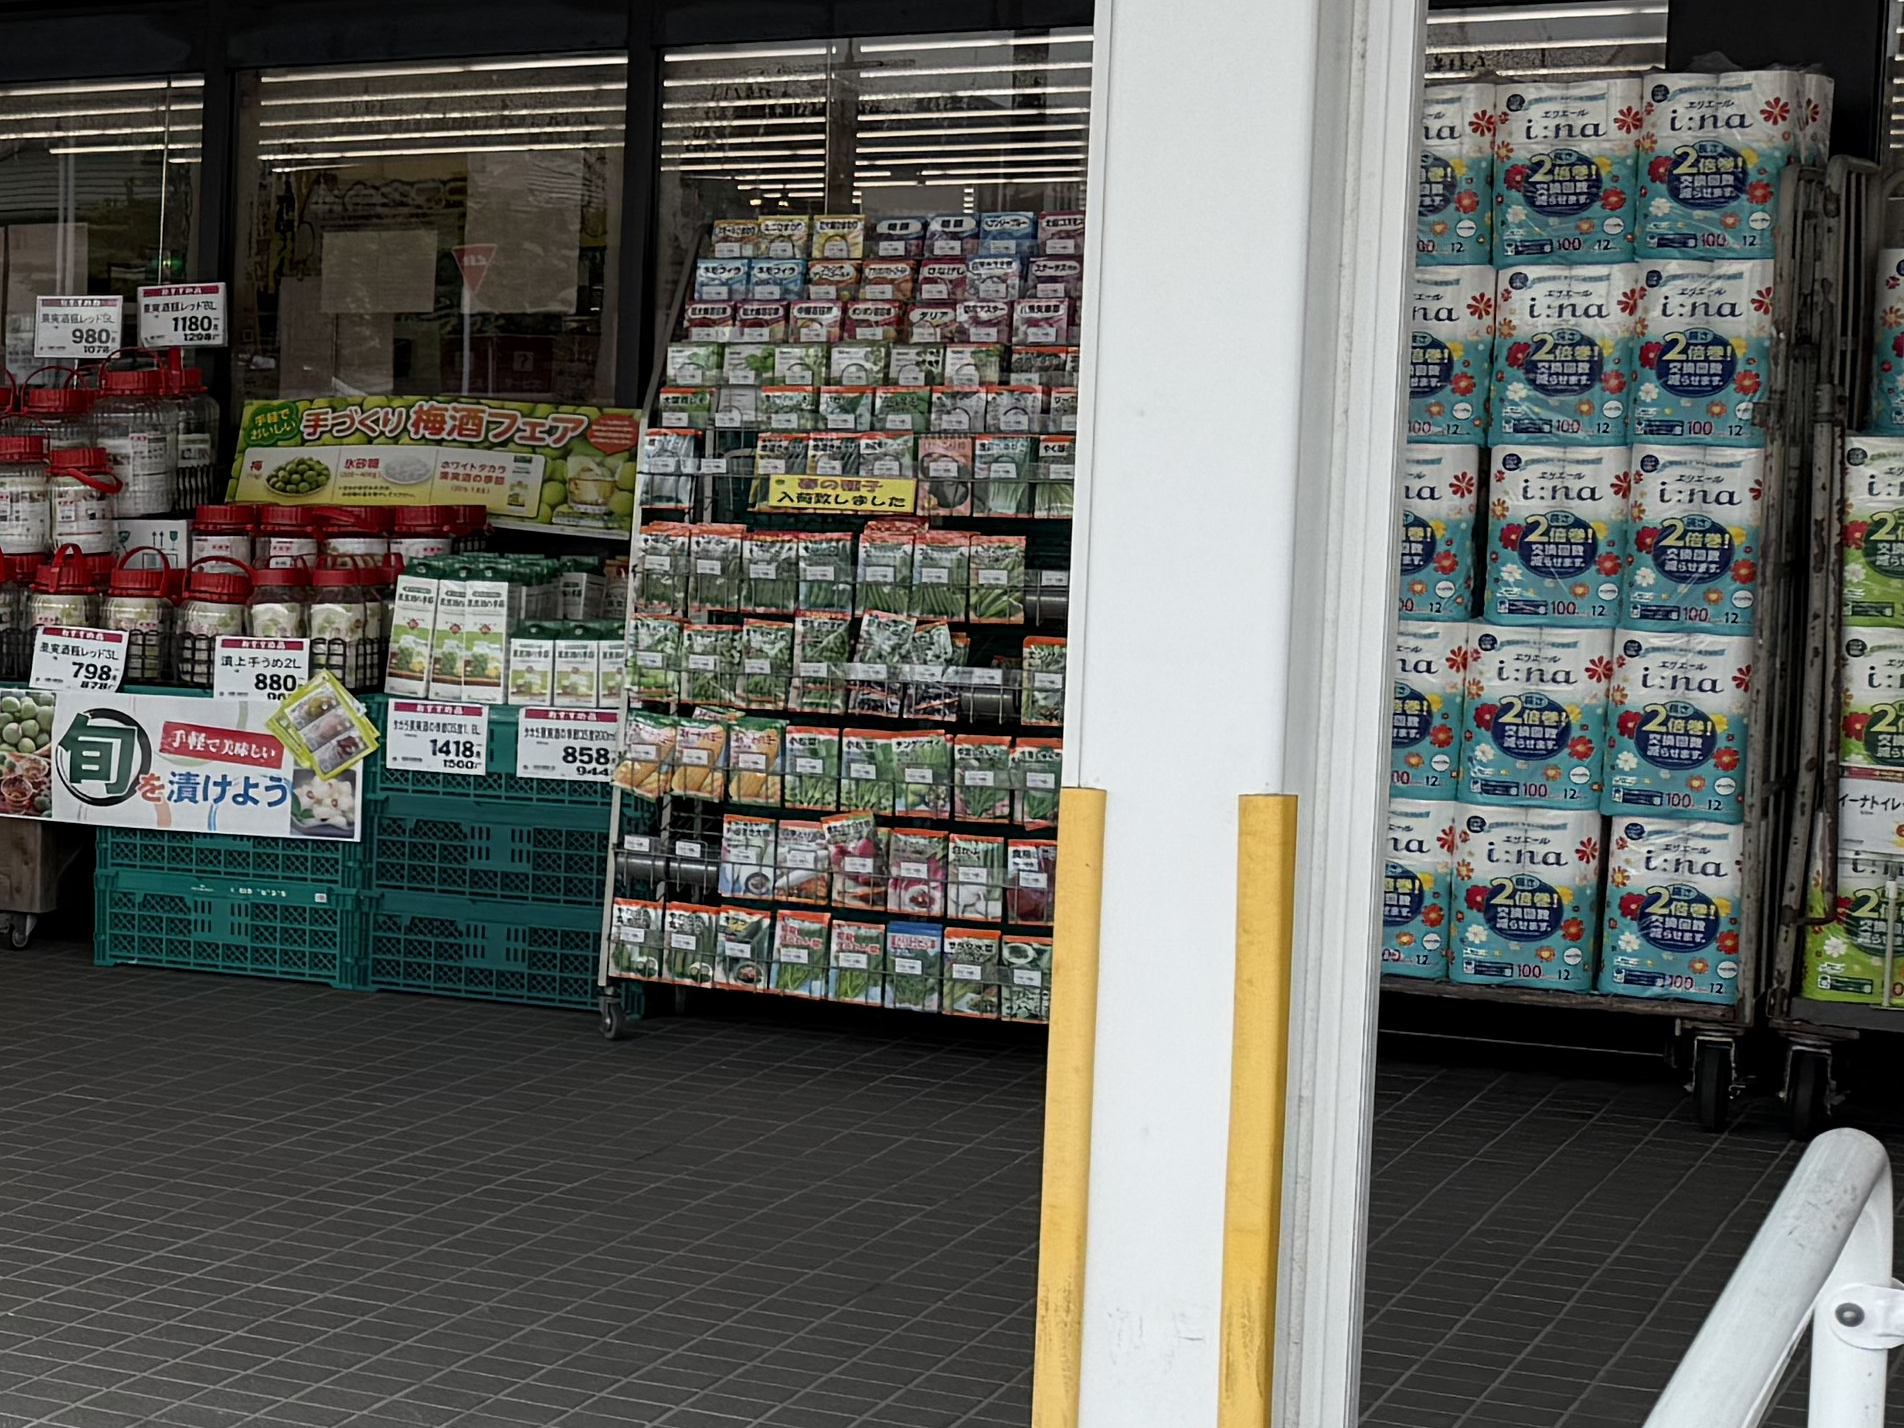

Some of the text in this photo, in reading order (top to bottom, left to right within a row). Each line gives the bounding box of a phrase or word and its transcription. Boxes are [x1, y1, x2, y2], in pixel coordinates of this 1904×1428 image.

[1557, 237, 1582, 250] 100
[1596, 239, 1612, 250] 12
[1701, 232, 1728, 247] 100
[1742, 234, 1757, 247] 12
[1450, 243, 1465, 253] 12
[172, 316, 213, 332] 1180
[71, 328, 111, 344] 980
[300, 401, 589, 449] 手づくり梅酒フェア
[1445, 422, 1462, 435] 12
[1555, 419, 1580, 434] 100
[1596, 422, 1610, 434] 12
[1687, 421, 1713, 436] 100
[1728, 424, 1743, 436] 12
[777, 491, 906, 508] 入荷致しました
[1682, 607, 1709, 622] 100
[1724, 611, 1739, 624] 12
[71, 662, 111, 681] 798
[254, 673, 298, 692] 880
[170, 729, 277, 761] 手軽で美味しい
[429, 738, 476, 759] 1418
[57, 712, 292, 807] 旬 を漬けよう
[562, 746, 610, 765] 858
[1517, 964, 1542, 978] 100
[1557, 969, 1571, 981] 12
